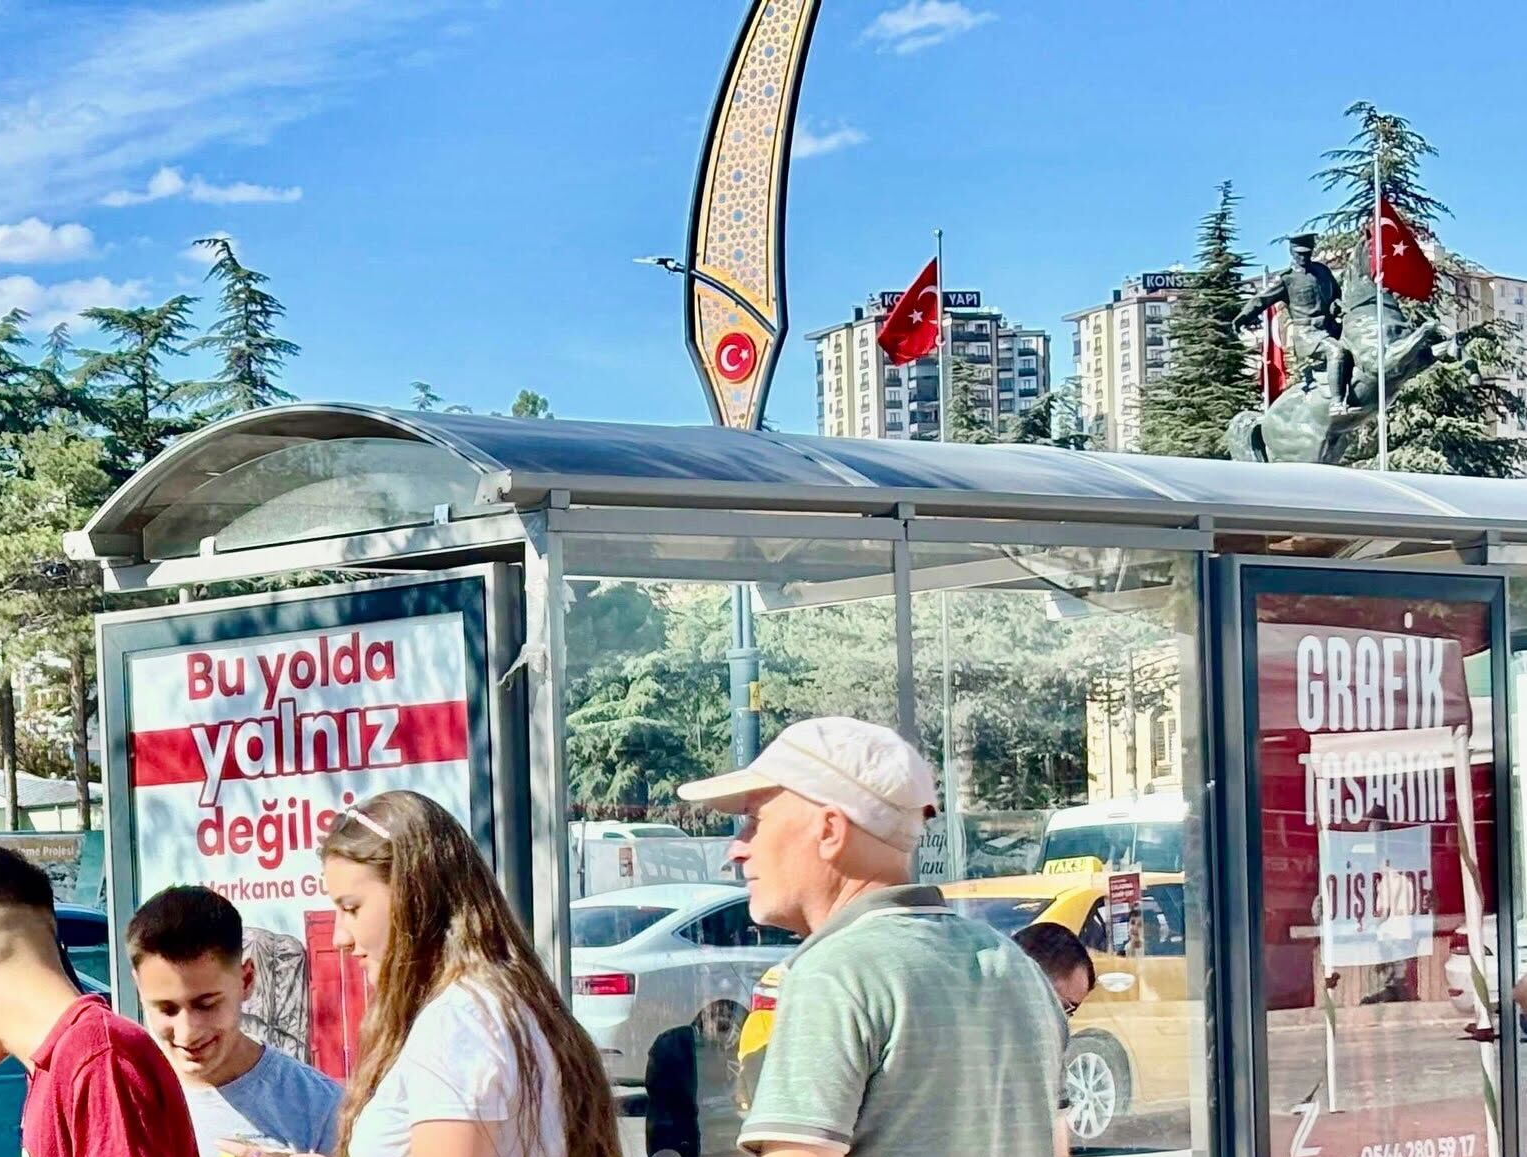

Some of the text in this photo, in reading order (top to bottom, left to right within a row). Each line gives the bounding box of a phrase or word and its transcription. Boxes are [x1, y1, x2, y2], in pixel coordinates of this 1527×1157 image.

[949, 293, 978, 306] YAPI
[187, 631, 396, 710] Bu yolda
[1297, 612, 1444, 732] GRAFİK
[189, 697, 402, 808] yalnız
[1298, 752, 1446, 826] TASARIM
[1345, 860, 1366, 932] İŞ
[1370, 859, 1430, 918] BİZDE
[1459, 1134, 1476, 1157] 17
